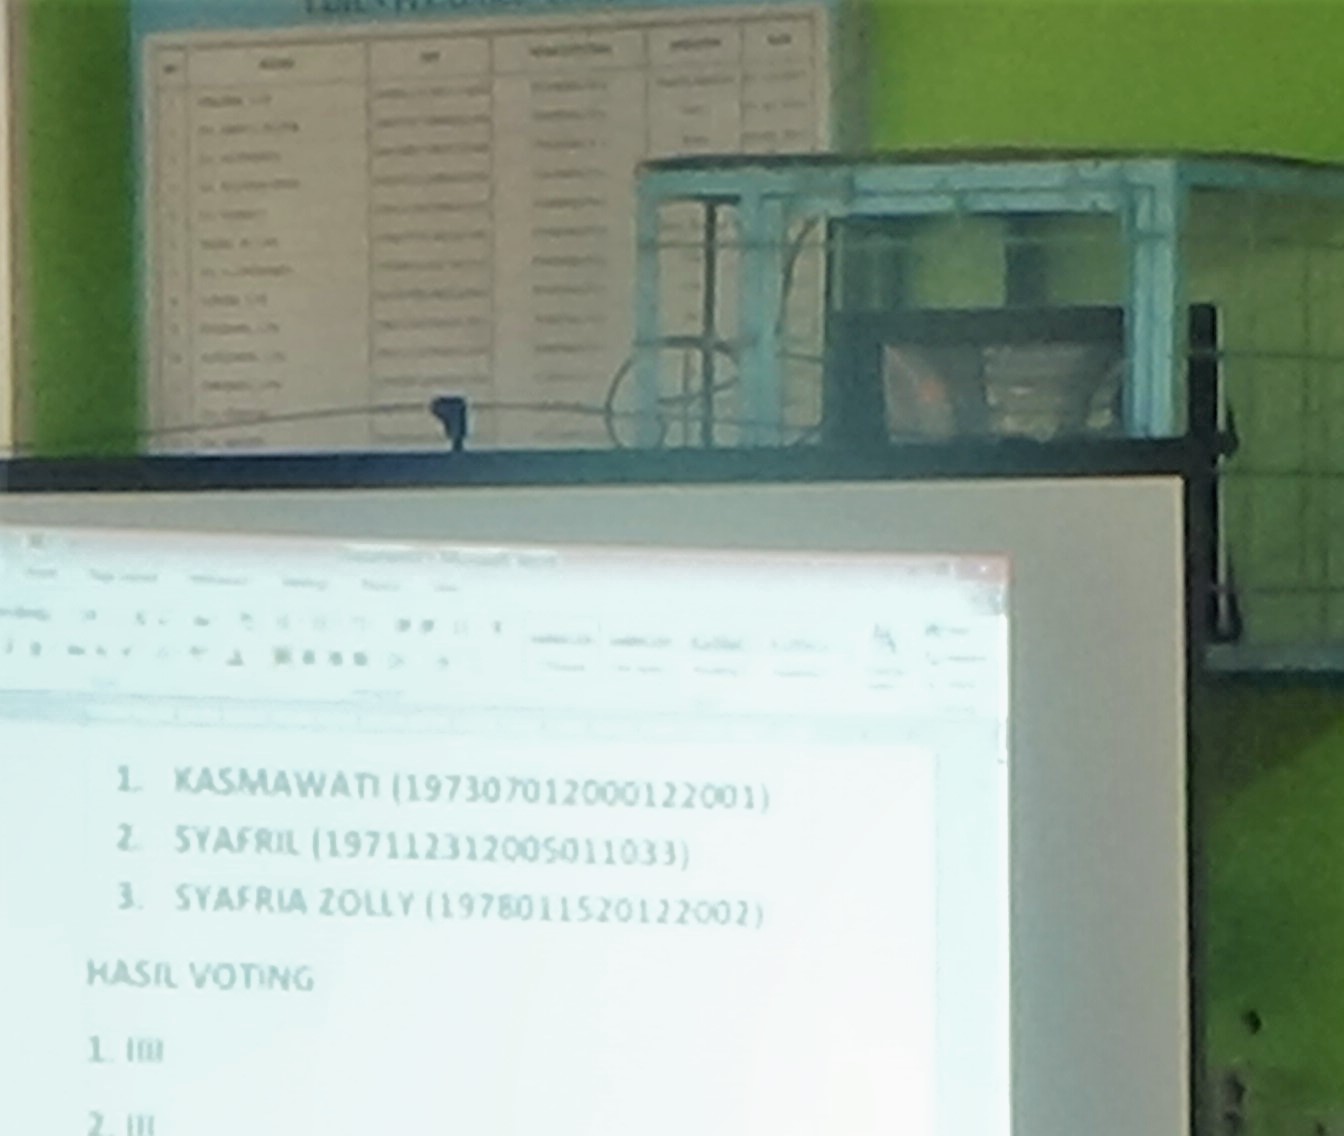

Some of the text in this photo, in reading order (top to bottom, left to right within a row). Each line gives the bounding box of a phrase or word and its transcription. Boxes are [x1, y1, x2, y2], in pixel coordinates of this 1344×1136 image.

[117, 765, 770, 813] 1. KASMAWATI (197307012000122001)
[117, 823, 690, 871] 2. SYAFRIL (197112312005011033)
[118, 881, 764, 929] 3. SYAFRIA ZOLLY (1978011520122002)
[86, 957, 314, 992] HASIL VOTING
[87, 1035, 115, 1063] 1.
